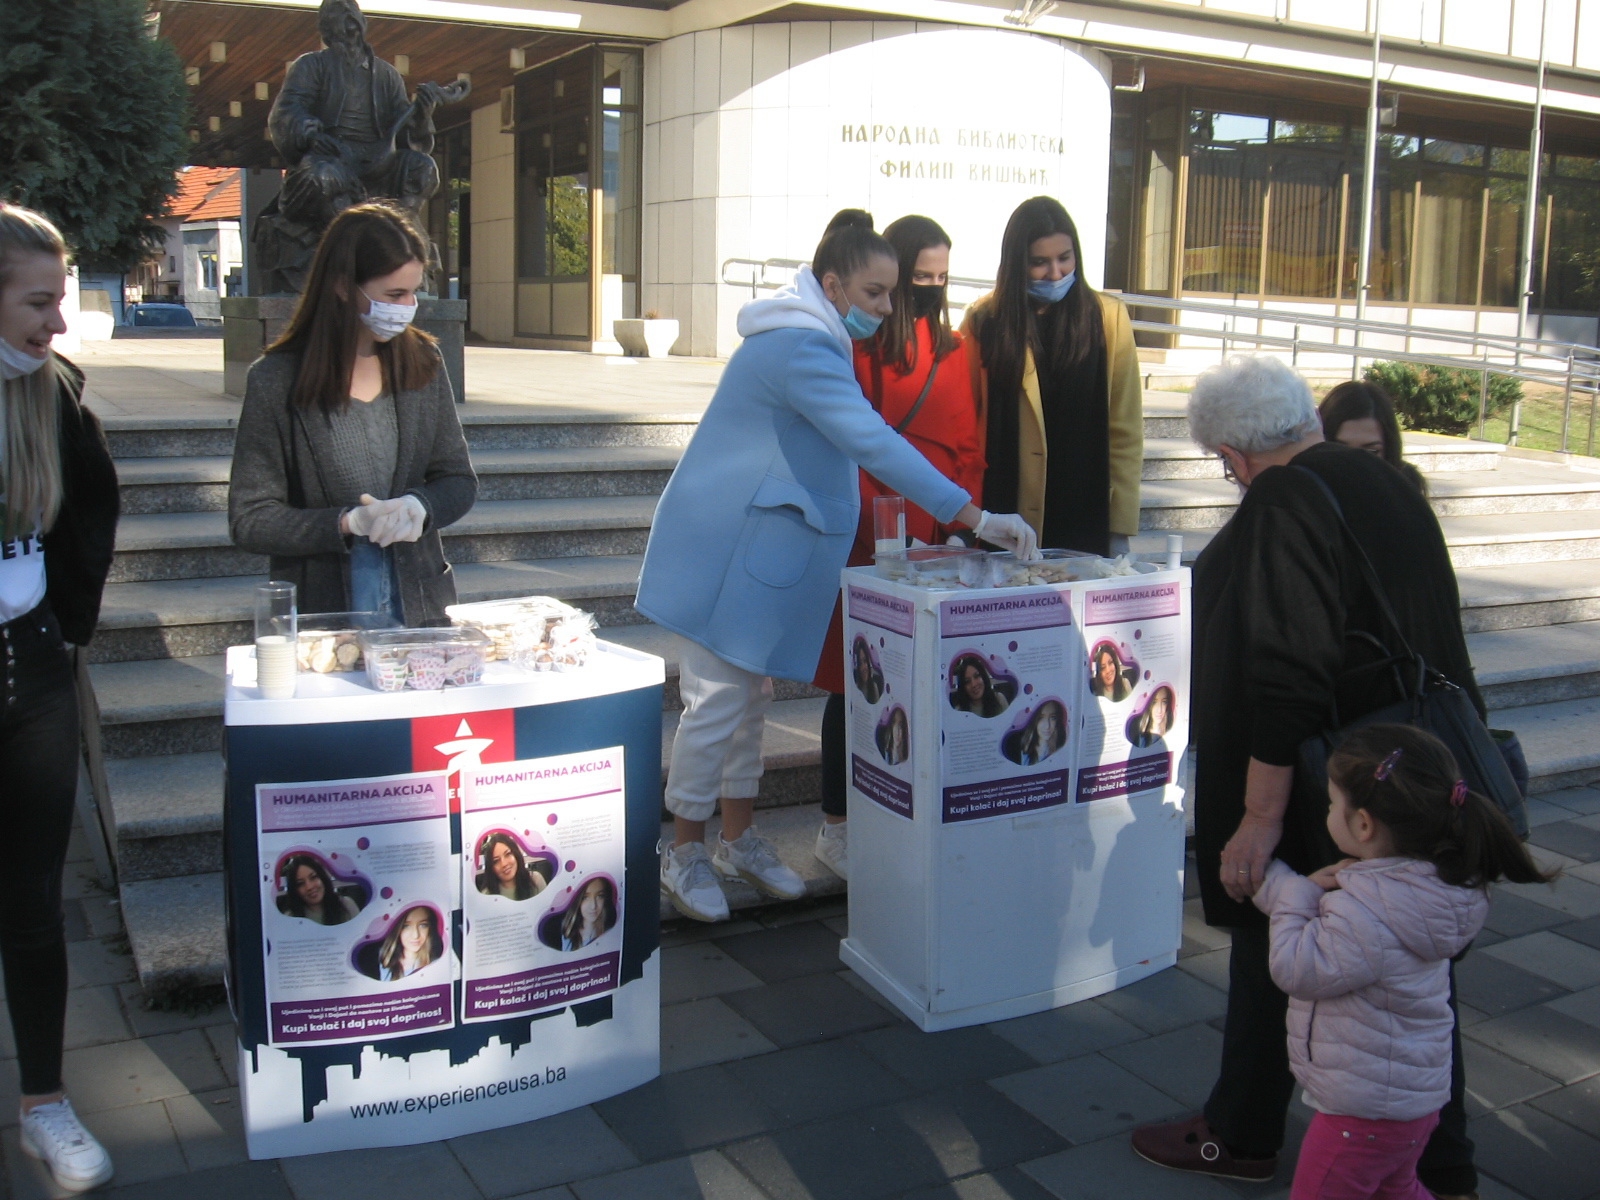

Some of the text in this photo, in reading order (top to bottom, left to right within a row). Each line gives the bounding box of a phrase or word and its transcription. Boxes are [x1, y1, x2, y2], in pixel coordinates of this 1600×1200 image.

[842, 124, 1065, 155] НАРОДНА БИБЛИОТЕКА
[880, 160, 1049, 186] ФИЛИП ВИШЊИЋ
[950, 596, 1063, 615] HUMANITARNA AKCIJA
[1092, 588, 1175, 604] HUMANITARNA AKCIJA
[475, 760, 612, 786] HUMANITARNA AKCIJA
[273, 788, 382, 806] HUMANITARNA
[383, 783, 434, 798] AKCIJA
[950, 805, 969, 815] Kupi
[970, 802, 992, 812] kolač
[997, 798, 1009, 808] daj
[1011, 796, 1027, 805] svoj
[1027, 789, 1062, 803] doprinos!
[1082, 786, 1098, 795] Kupi
[474, 974, 611, 1010] Kupi kolač i daj svoj doprinos!
[282, 1007, 443, 1035] Kupi kolač i daj svoj doprinos!
[350, 1066, 567, 1119] www.experienceusa.ba
